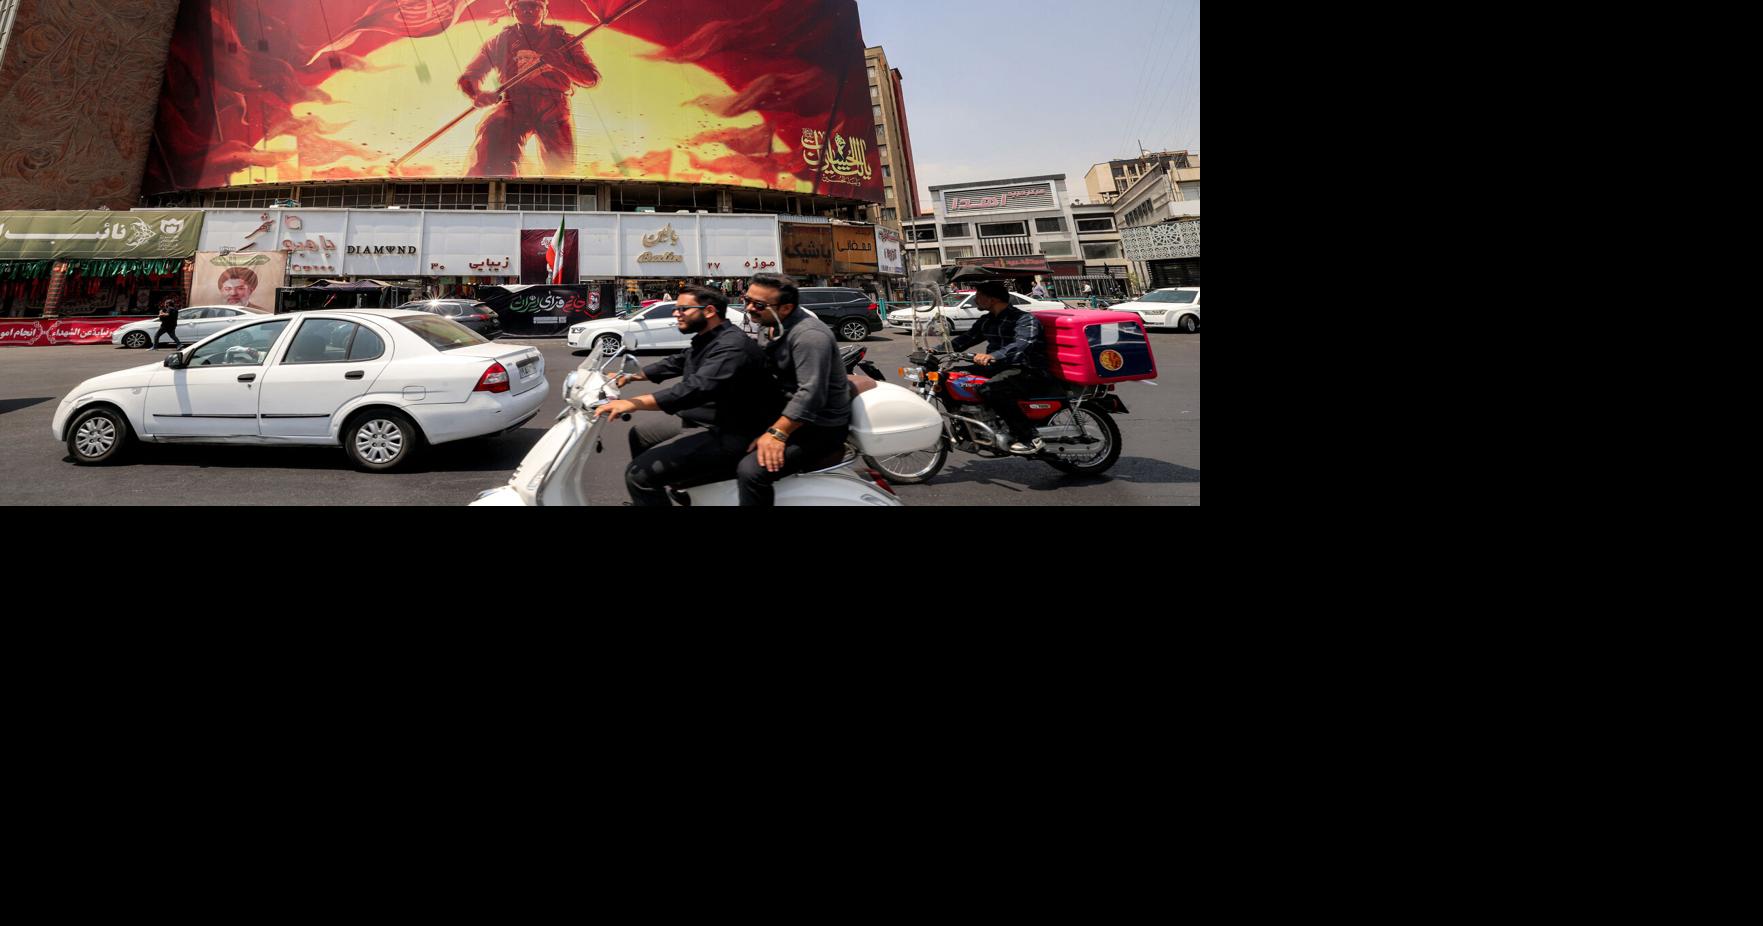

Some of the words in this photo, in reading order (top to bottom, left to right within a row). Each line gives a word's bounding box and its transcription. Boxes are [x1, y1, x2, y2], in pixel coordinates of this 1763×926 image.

[4, 223, 127, 245] نائب
[469, 257, 509, 271] زیبایی
[744, 258, 776, 269] موزه
[13, 328, 37, 338] انجام
